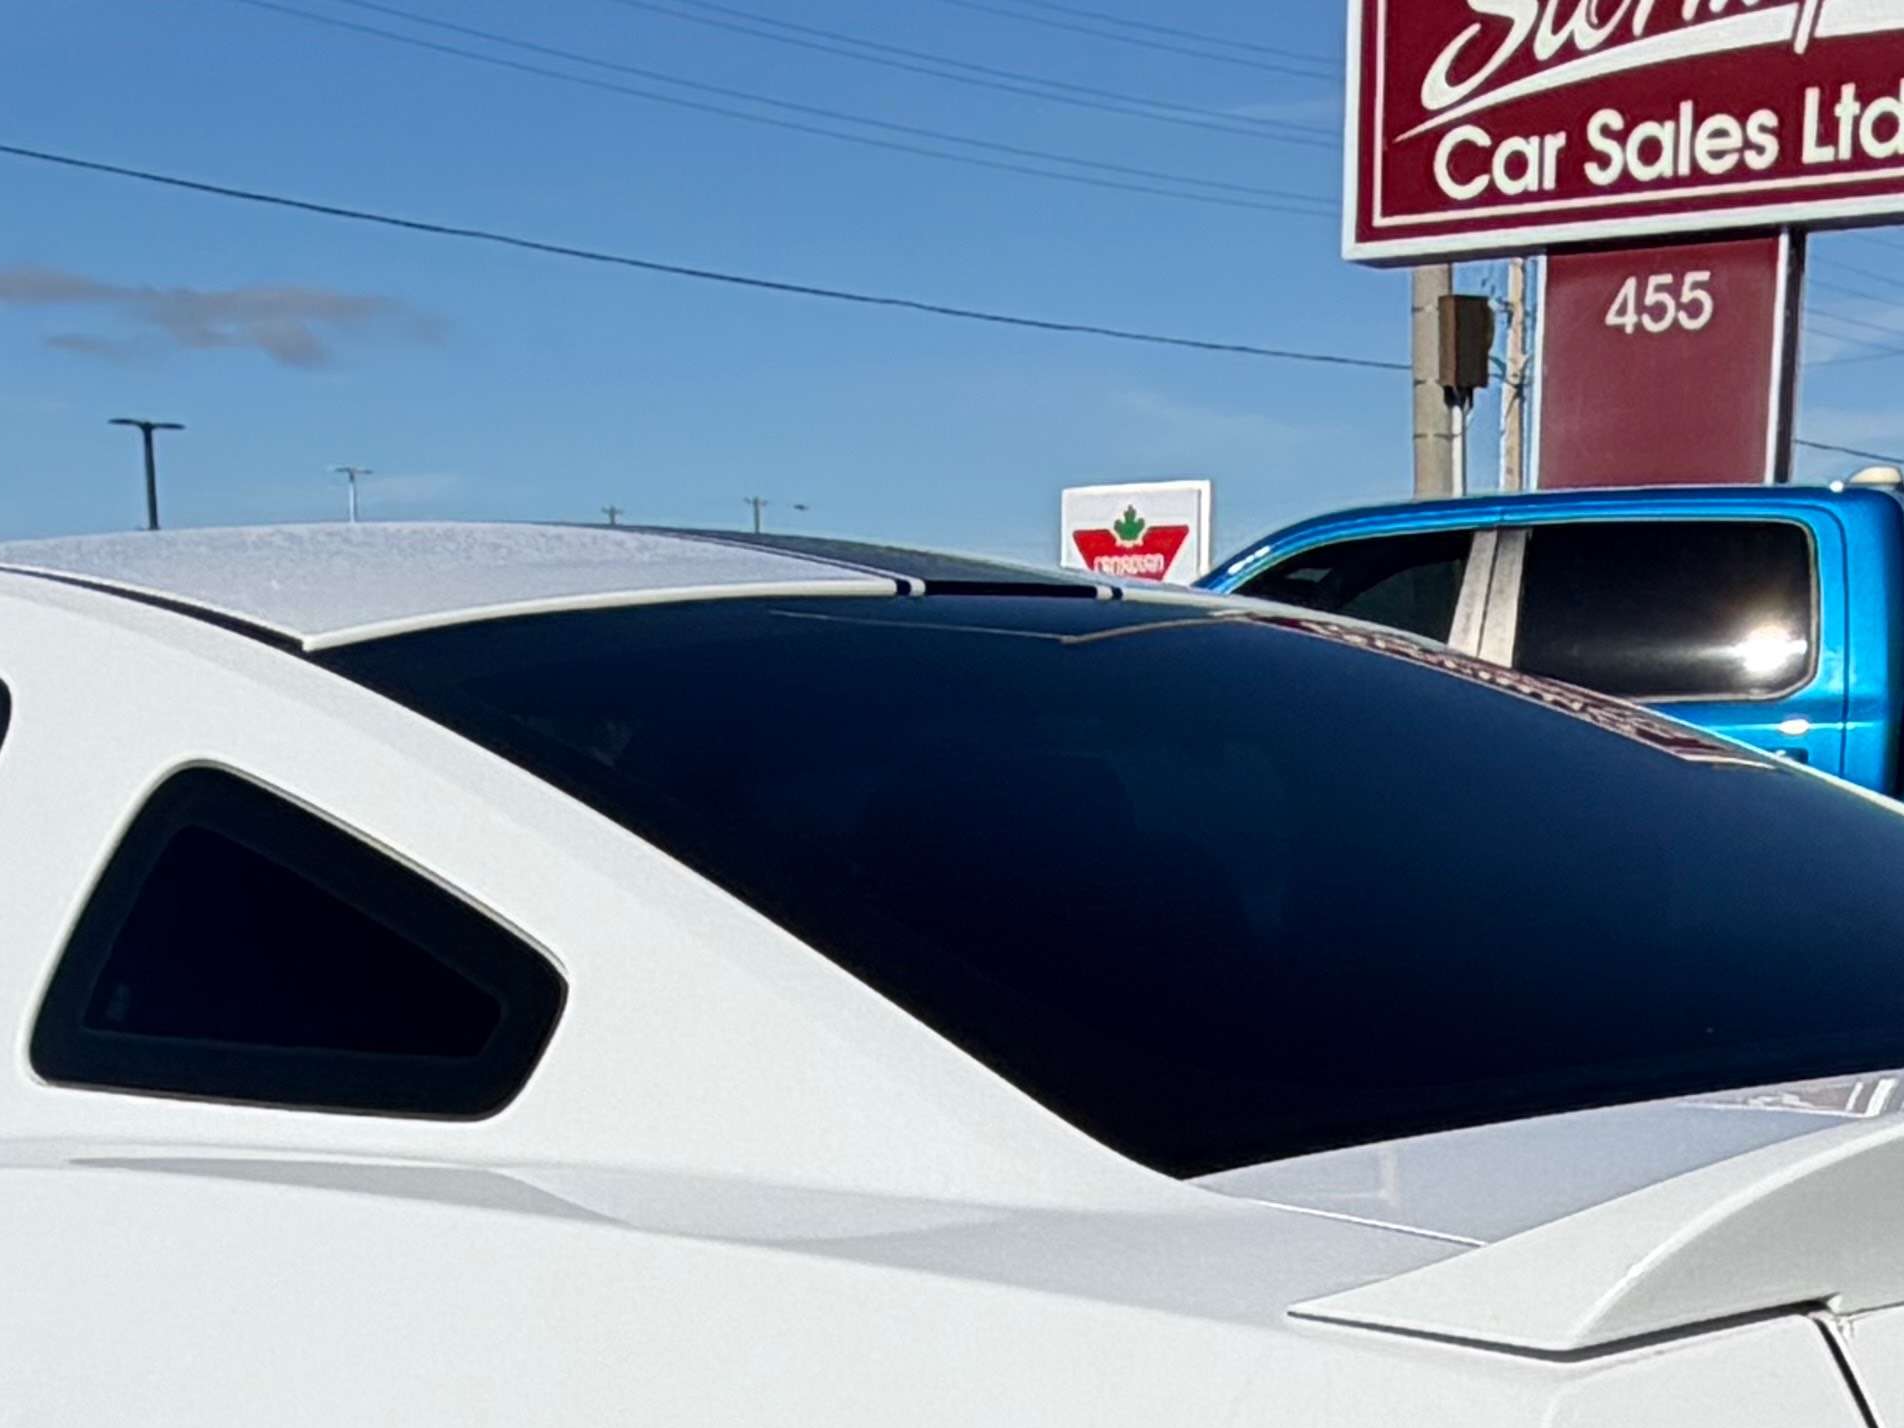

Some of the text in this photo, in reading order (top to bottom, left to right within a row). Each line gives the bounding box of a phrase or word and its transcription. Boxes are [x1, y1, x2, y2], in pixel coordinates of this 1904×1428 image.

[1434, 124, 1566, 200] Car
[1583, 100, 1780, 186] Sales
[1605, 270, 1714, 335] 455
